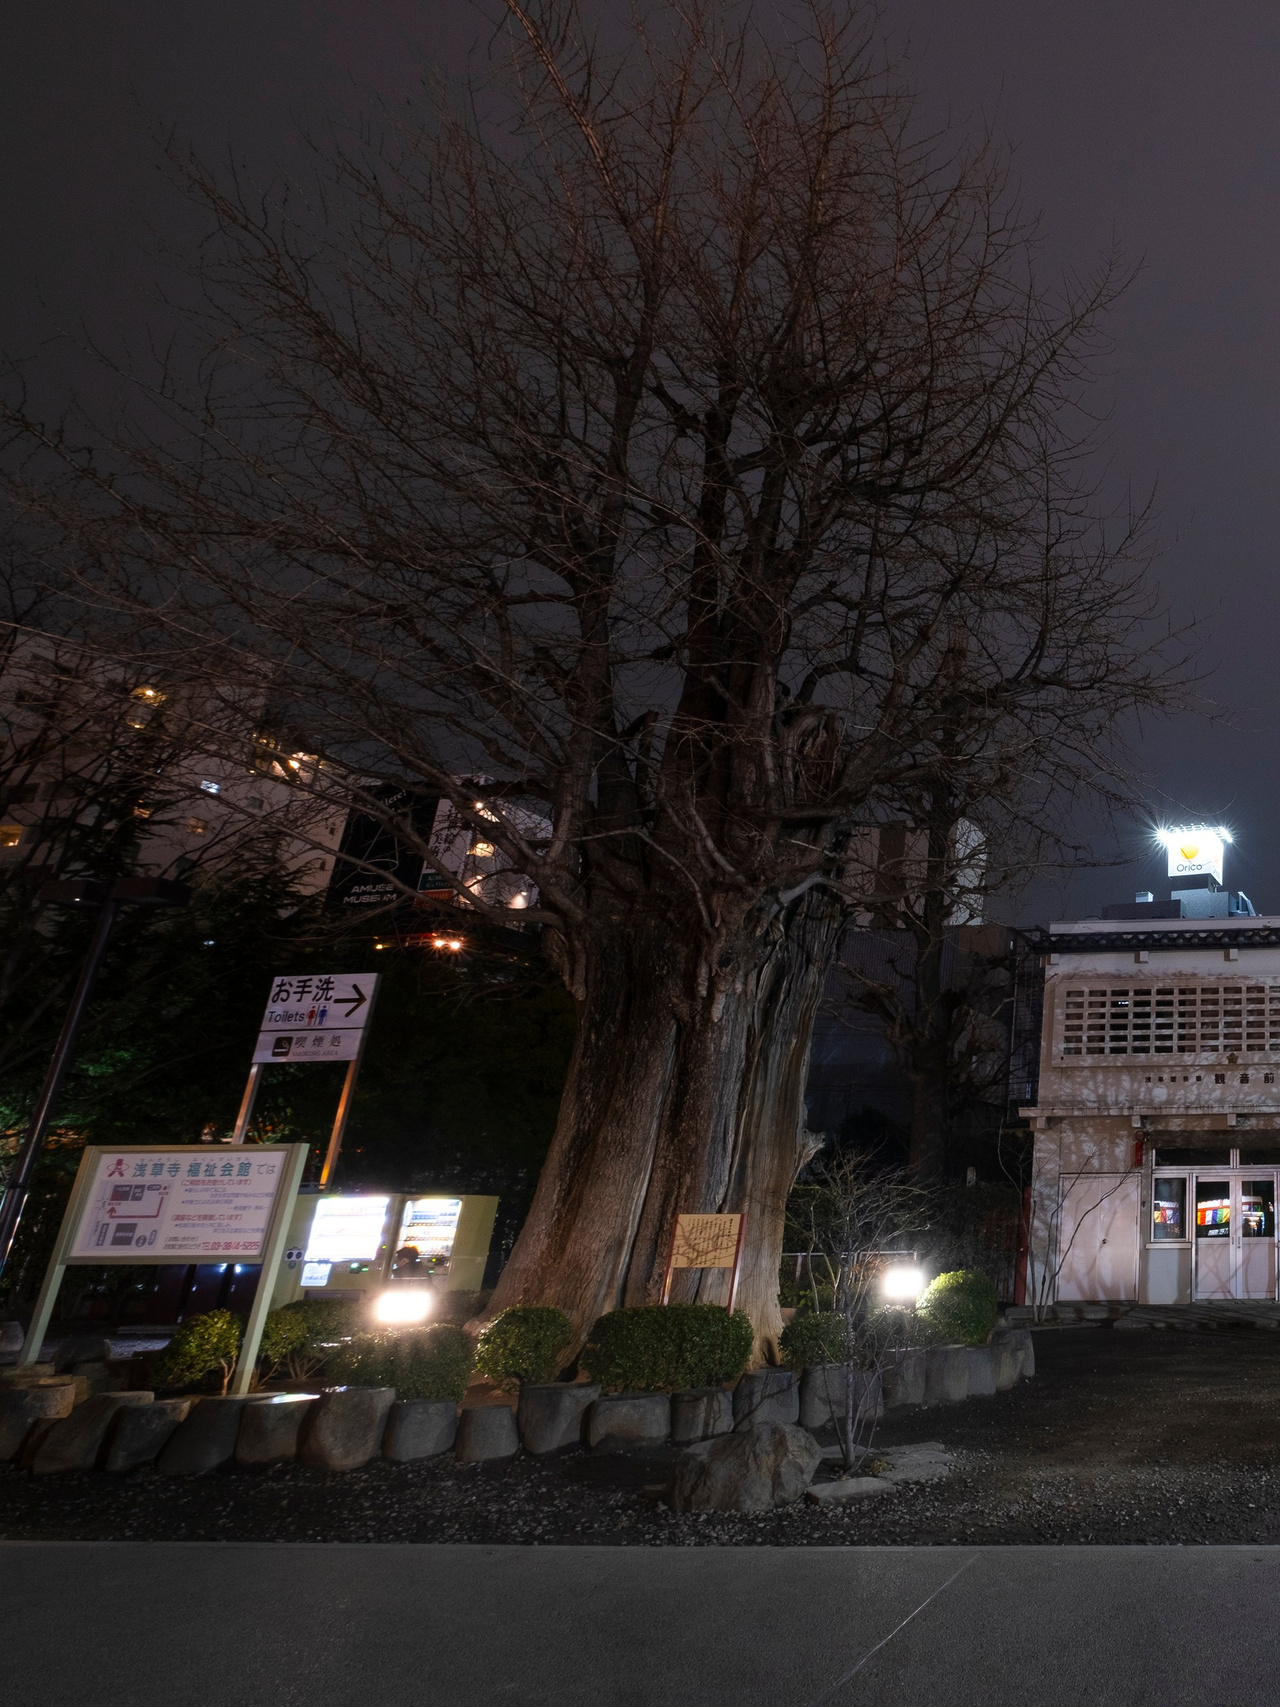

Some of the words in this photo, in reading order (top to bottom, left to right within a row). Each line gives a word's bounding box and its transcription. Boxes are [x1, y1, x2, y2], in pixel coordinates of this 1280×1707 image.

[1176, 863, 1203, 873] Orico
[350, 884, 395, 894] AMUSE
[271, 976, 335, 1003] お手洗
[268, 1010, 305, 1023] Toilets
[294, 1035, 341, 1048] 喫煙処
[132, 1162, 180, 1178] 浅草寺
[187, 1160, 253, 1178] 福祉会館
[257, 1163, 277, 1175] では
